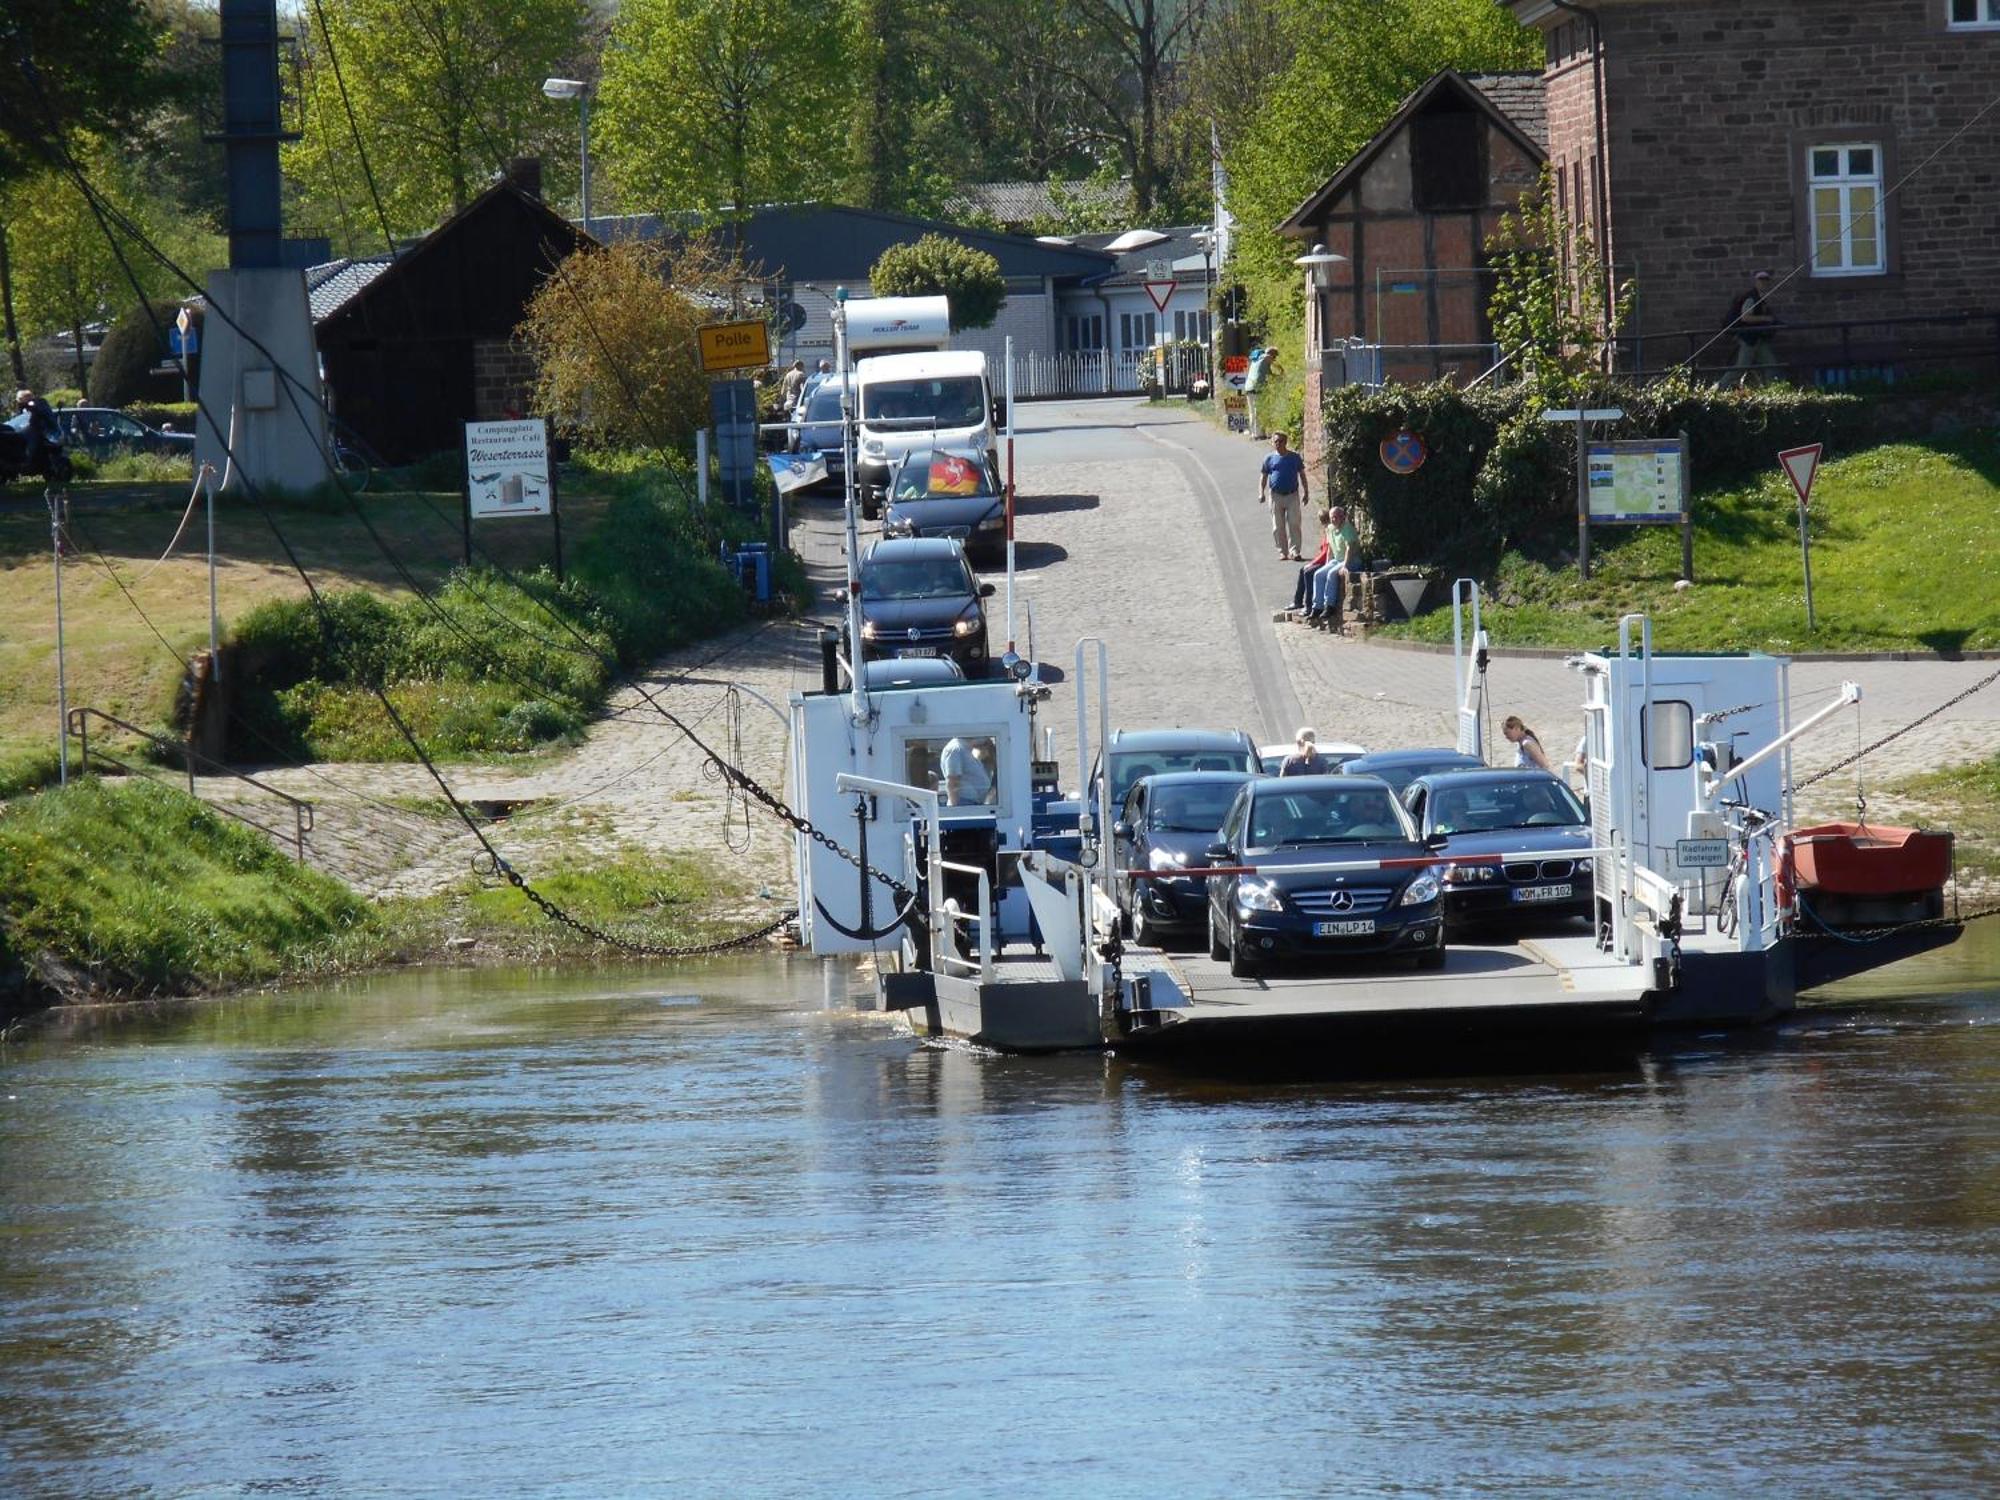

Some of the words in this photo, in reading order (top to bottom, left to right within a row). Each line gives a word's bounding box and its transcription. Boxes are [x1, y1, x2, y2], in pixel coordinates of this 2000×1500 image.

[900, 323, 919, 332] TEAM
[715, 331, 751, 348] Polle
[477, 424, 534, 435] Campingplatz
[471, 435, 515, 445] Restaurant
[470, 448, 545, 462] Weserterrasse
[1682, 844, 1722, 853] Radfahrer
[1683, 854, 1722, 863] absteigen
[1319, 923, 1340, 934] EIN
[1346, 922, 1360, 933] LP
[1361, 920, 1374, 933] 14
